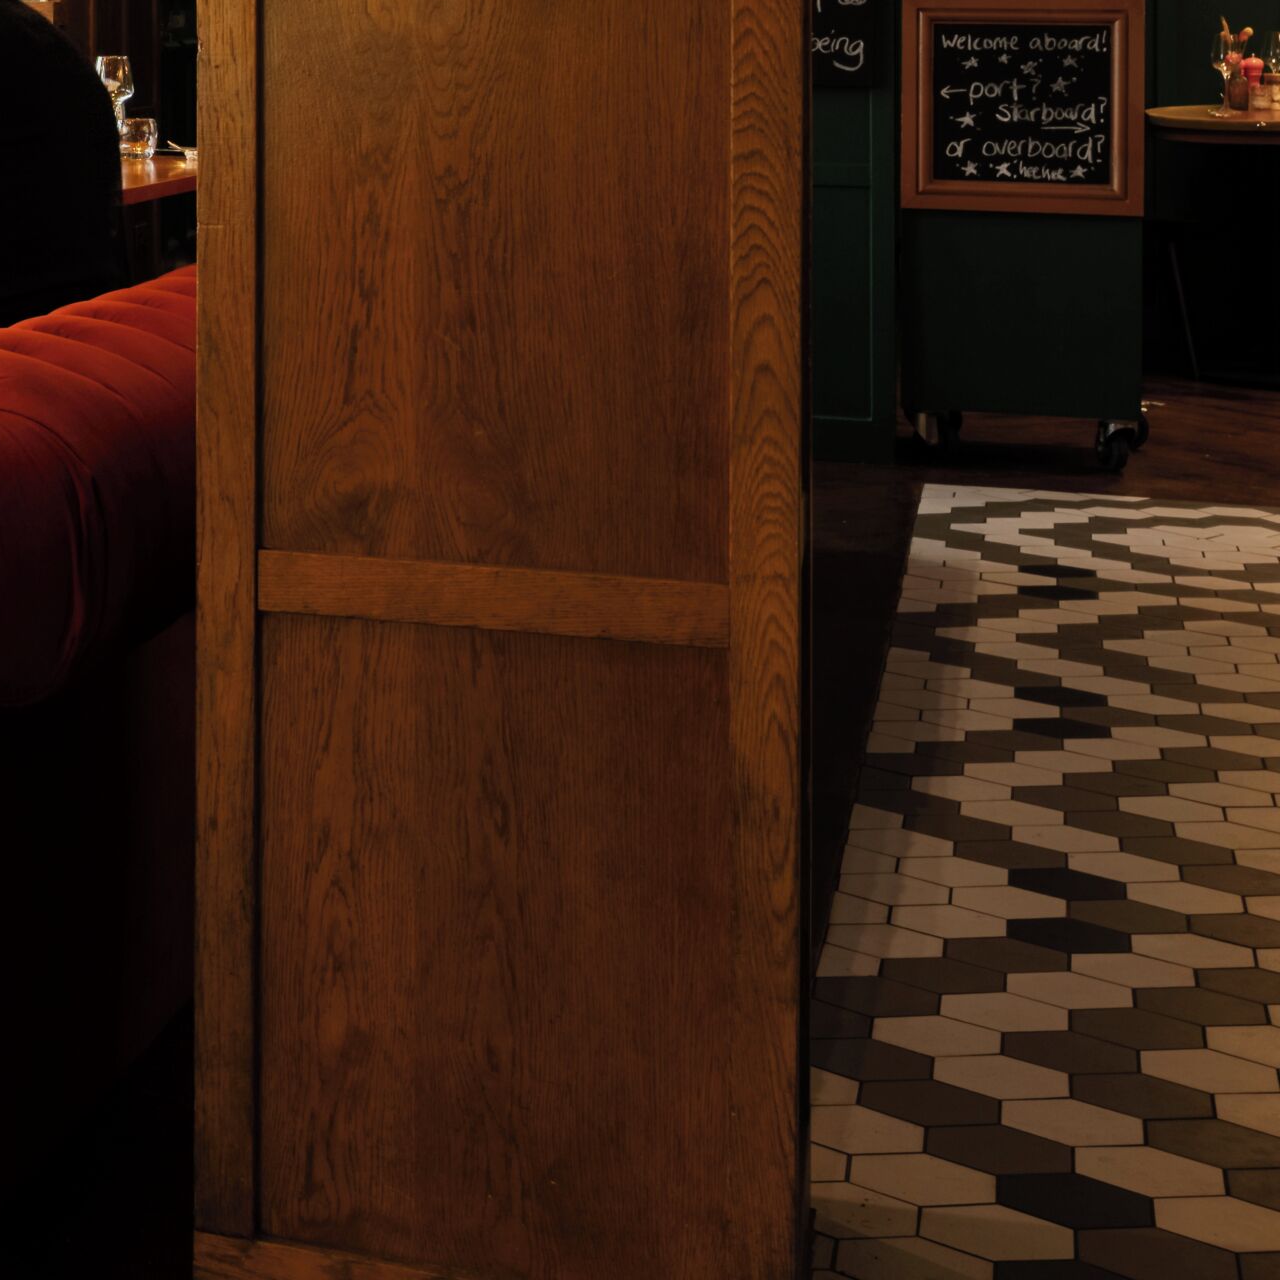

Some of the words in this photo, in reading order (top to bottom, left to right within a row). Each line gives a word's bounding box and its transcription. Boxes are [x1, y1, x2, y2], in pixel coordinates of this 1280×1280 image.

[1029, 30, 1108, 52] aboard!
[946, 138, 972, 157] or
[982, 135, 1106, 163] overboard?
